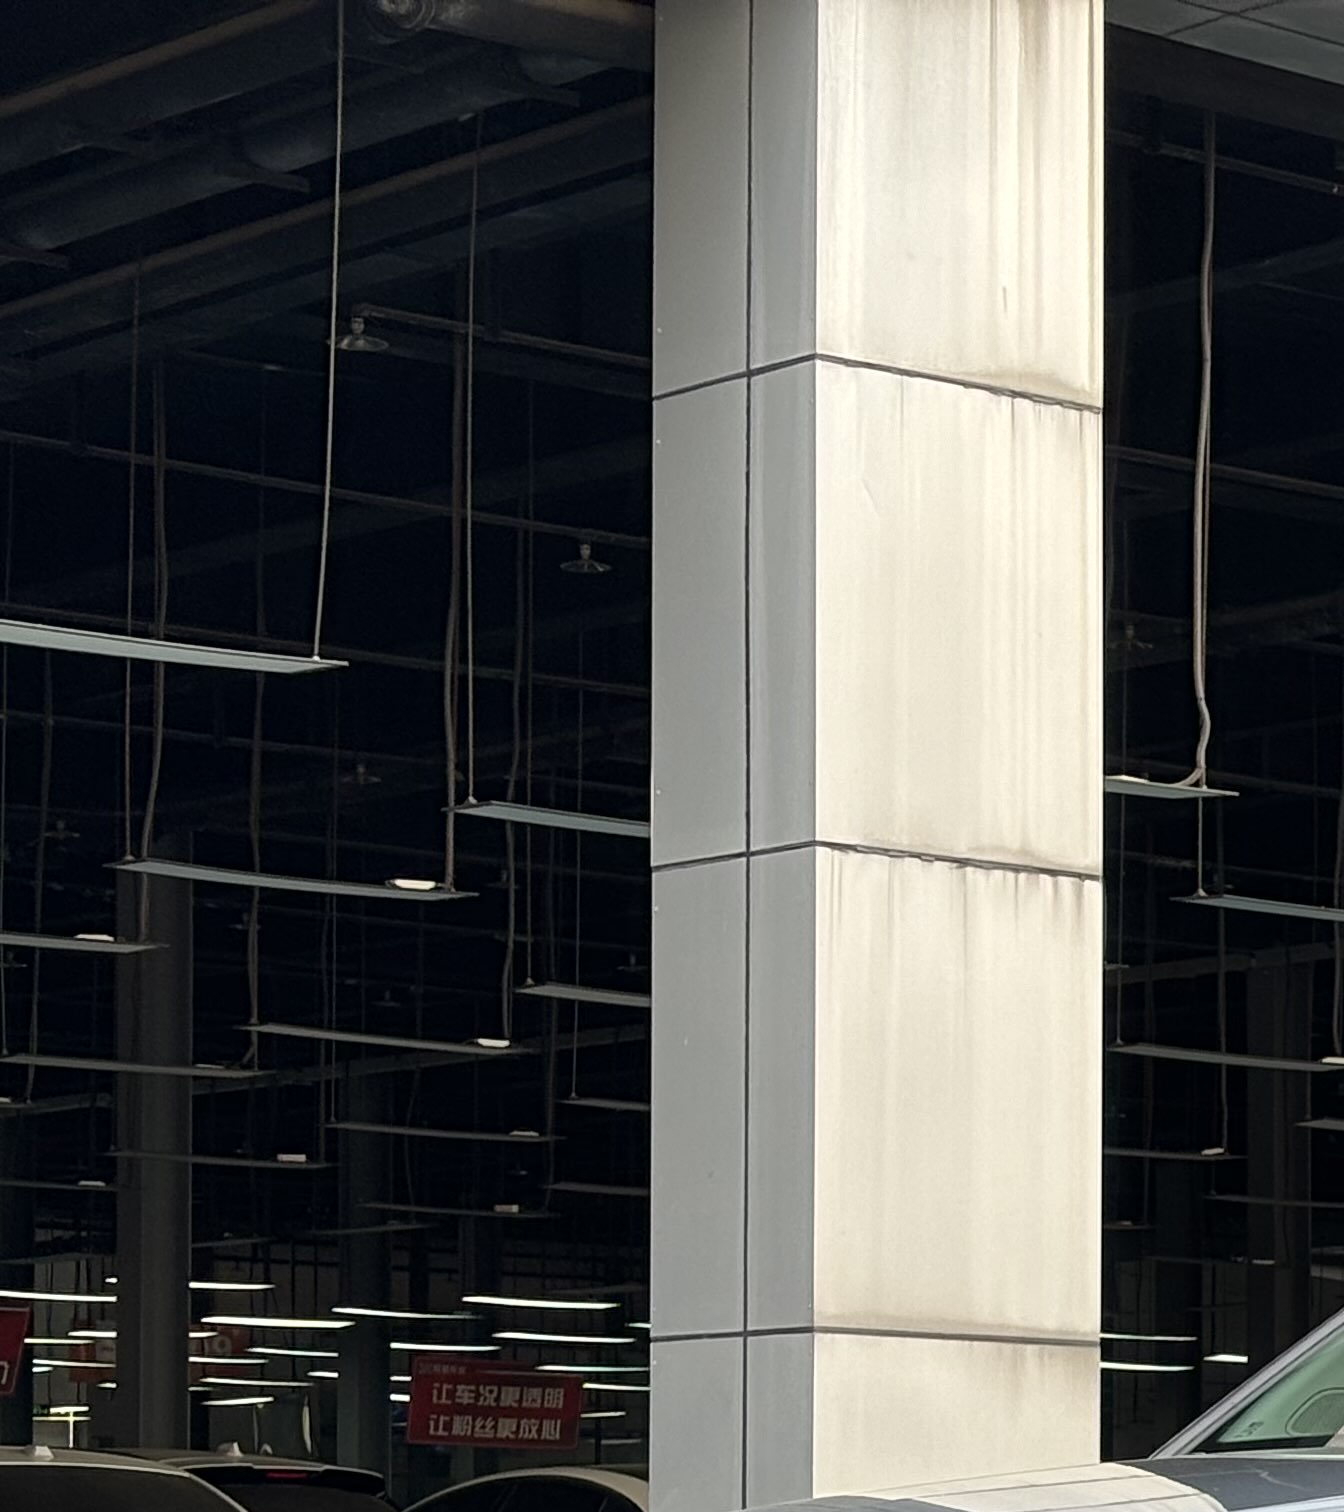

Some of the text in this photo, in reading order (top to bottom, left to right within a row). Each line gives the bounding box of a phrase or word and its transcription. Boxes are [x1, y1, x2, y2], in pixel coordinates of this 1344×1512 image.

[432, 1382, 564, 1409] 让车况更透明
[428, 1414, 561, 1440] 让粉丝更放心
